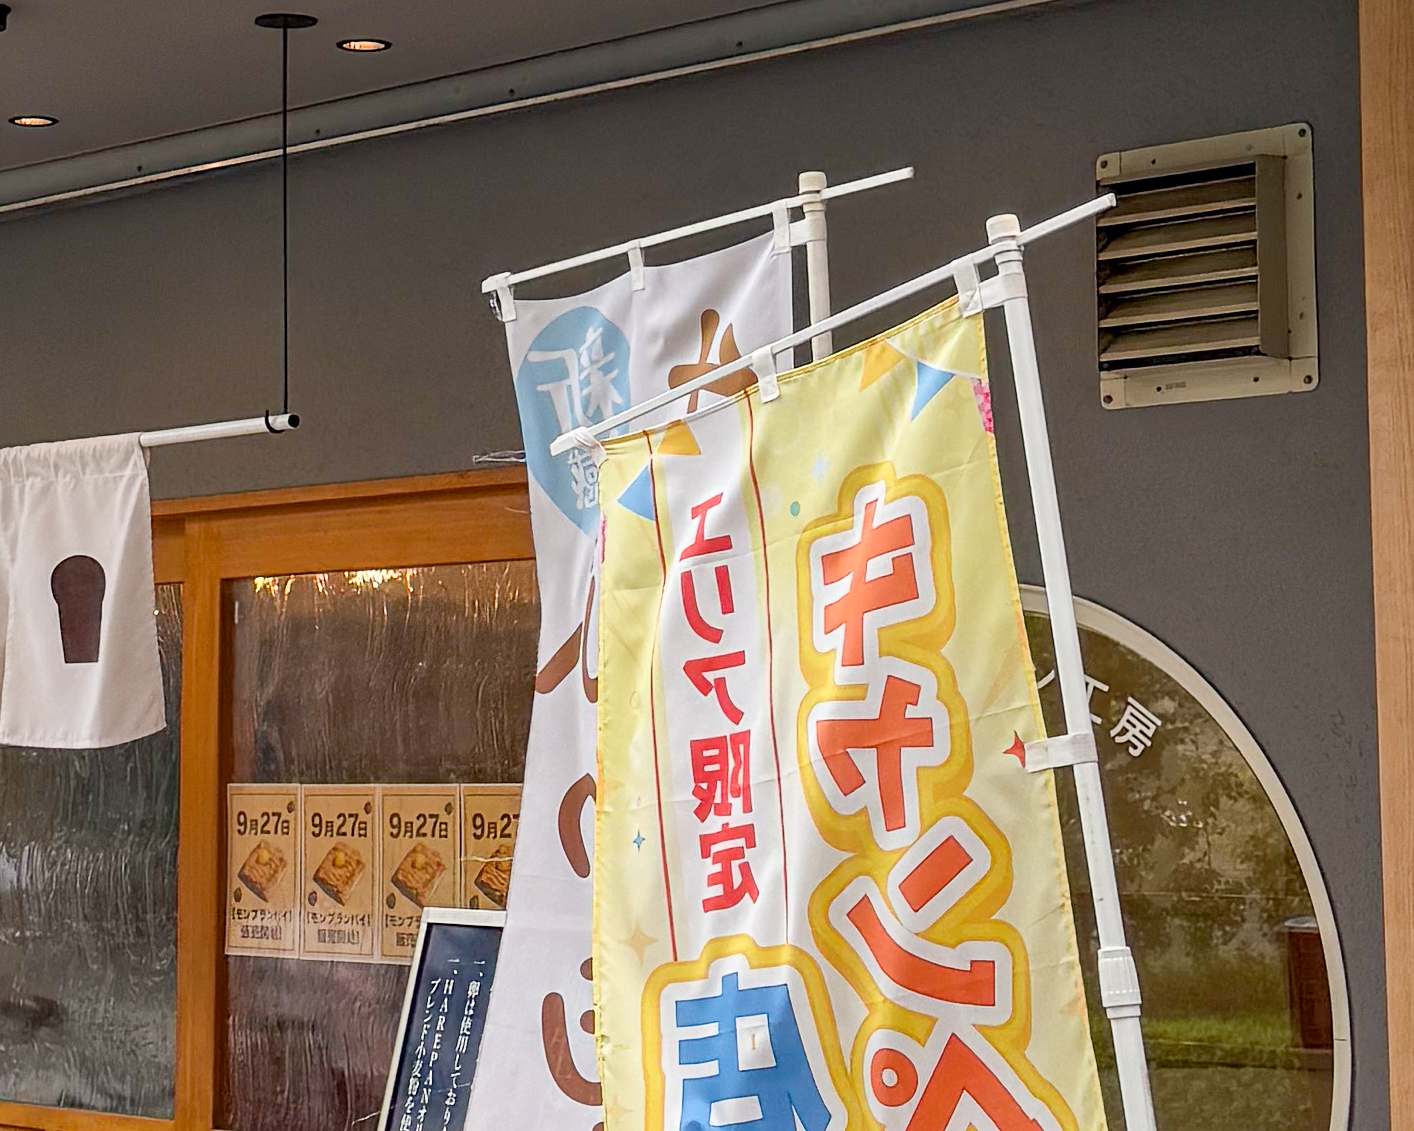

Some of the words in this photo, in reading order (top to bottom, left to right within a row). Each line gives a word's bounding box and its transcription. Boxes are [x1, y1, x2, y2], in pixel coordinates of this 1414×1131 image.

[236, 810, 290, 836] 9月27日
[311, 812, 368, 838] 9月27日
[389, 812, 448, 839] 9月27日
